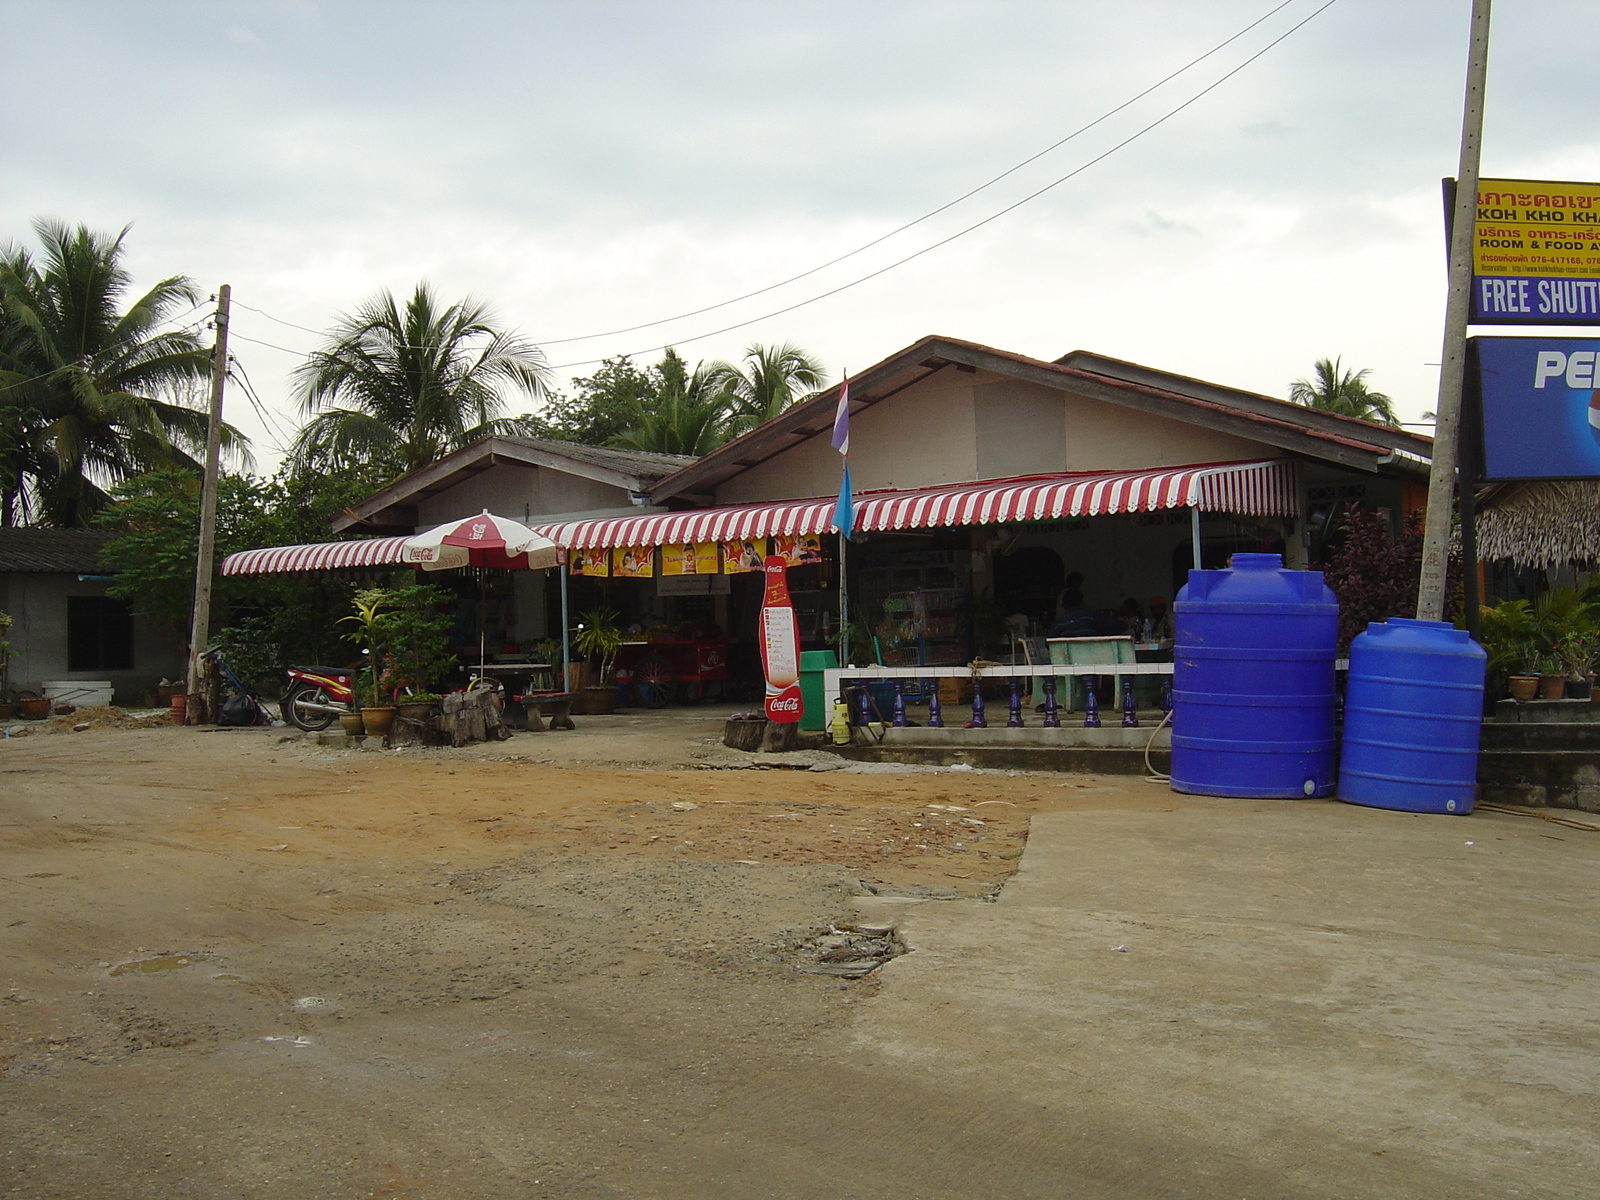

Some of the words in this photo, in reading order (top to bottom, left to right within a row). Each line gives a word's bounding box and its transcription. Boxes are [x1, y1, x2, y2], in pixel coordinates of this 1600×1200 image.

[1478, 208, 1517, 220] KOH
[1526, 210, 1564, 222] KHO
[1478, 226, 1521, 238] บริการ
[1480, 239, 1524, 249] ROOM
[1531, 241, 1540, 249] &
[1545, 241, 1584, 250] FOOD
[1590, 242, 1600, 250] A
[1481, 280, 1531, 313] FREE
[1537, 280, 1600, 314] SHUTT
[1534, 351, 1600, 389] PE
